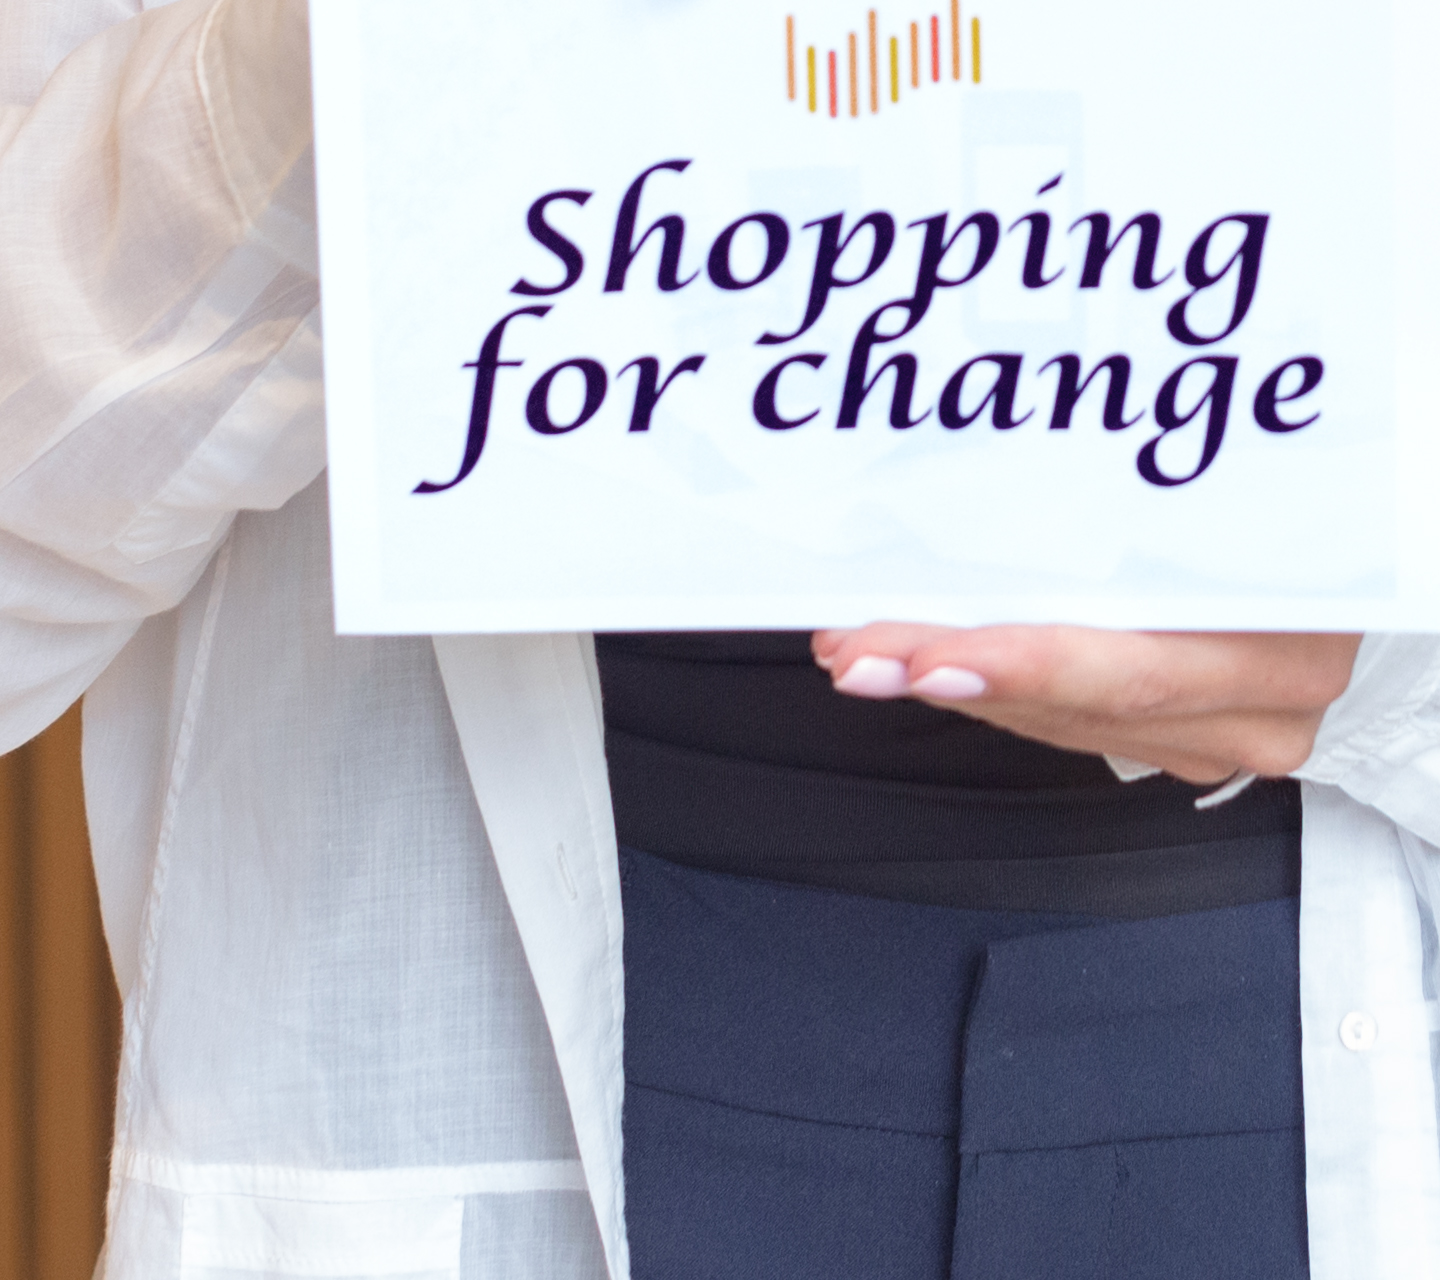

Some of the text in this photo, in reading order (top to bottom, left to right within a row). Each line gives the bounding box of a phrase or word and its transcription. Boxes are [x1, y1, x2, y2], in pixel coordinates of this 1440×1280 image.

[510, 159, 1271, 347] Shopping
[411, 298, 1325, 495] for change
